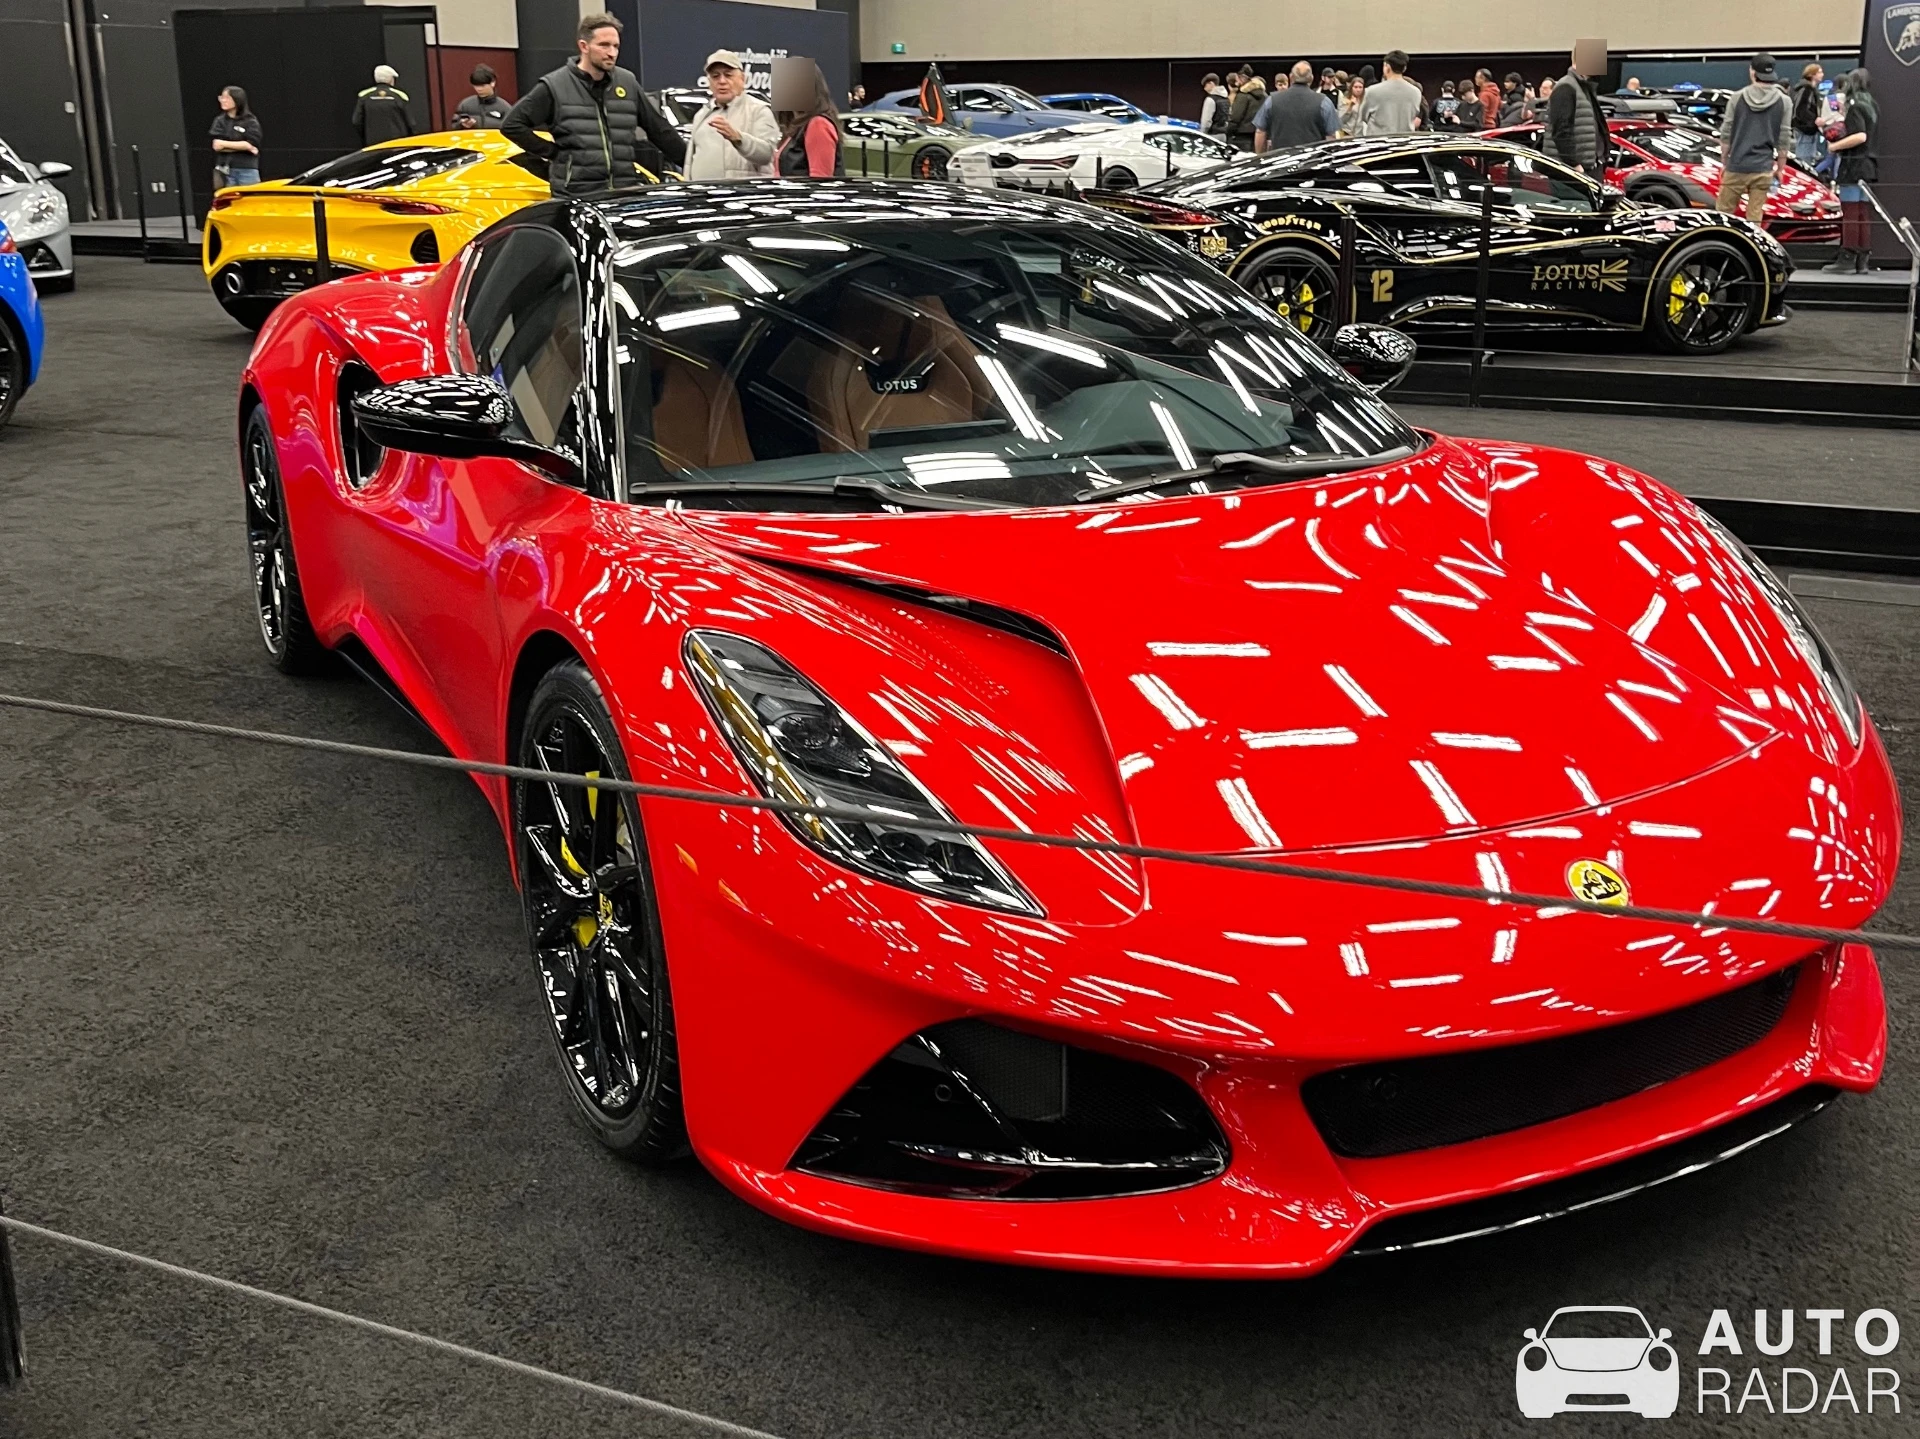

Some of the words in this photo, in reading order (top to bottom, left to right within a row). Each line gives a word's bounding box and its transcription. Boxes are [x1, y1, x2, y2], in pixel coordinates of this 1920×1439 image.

[1532, 264, 1600, 281] LOTUS
[1371, 269, 1394, 303] 12
[1530, 280, 1599, 290] RACING
[876, 379, 918, 391] LOTUS
